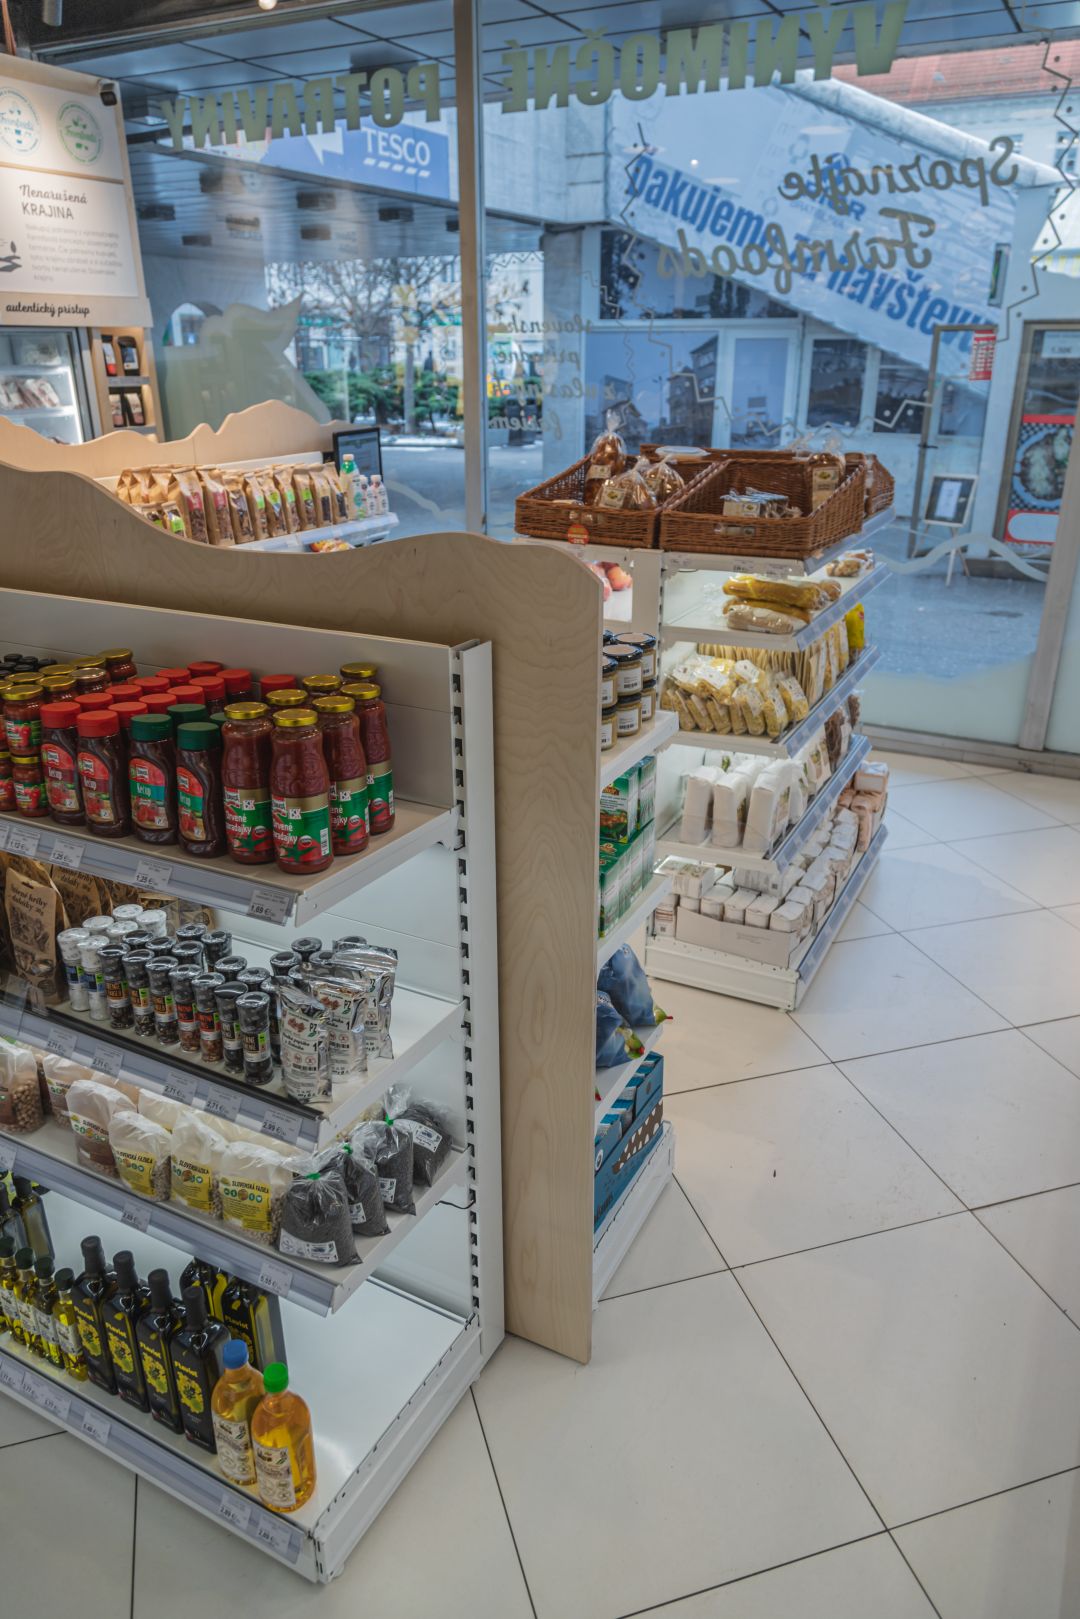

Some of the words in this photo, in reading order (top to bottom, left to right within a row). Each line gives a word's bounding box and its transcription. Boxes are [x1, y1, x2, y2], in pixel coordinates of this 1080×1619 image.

[361, 127, 431, 167] TESCO
[19, 183, 88, 205] Nenarušená
[22, 202, 74, 220] KRAJINA
[6, 301, 56, 318] autentický
